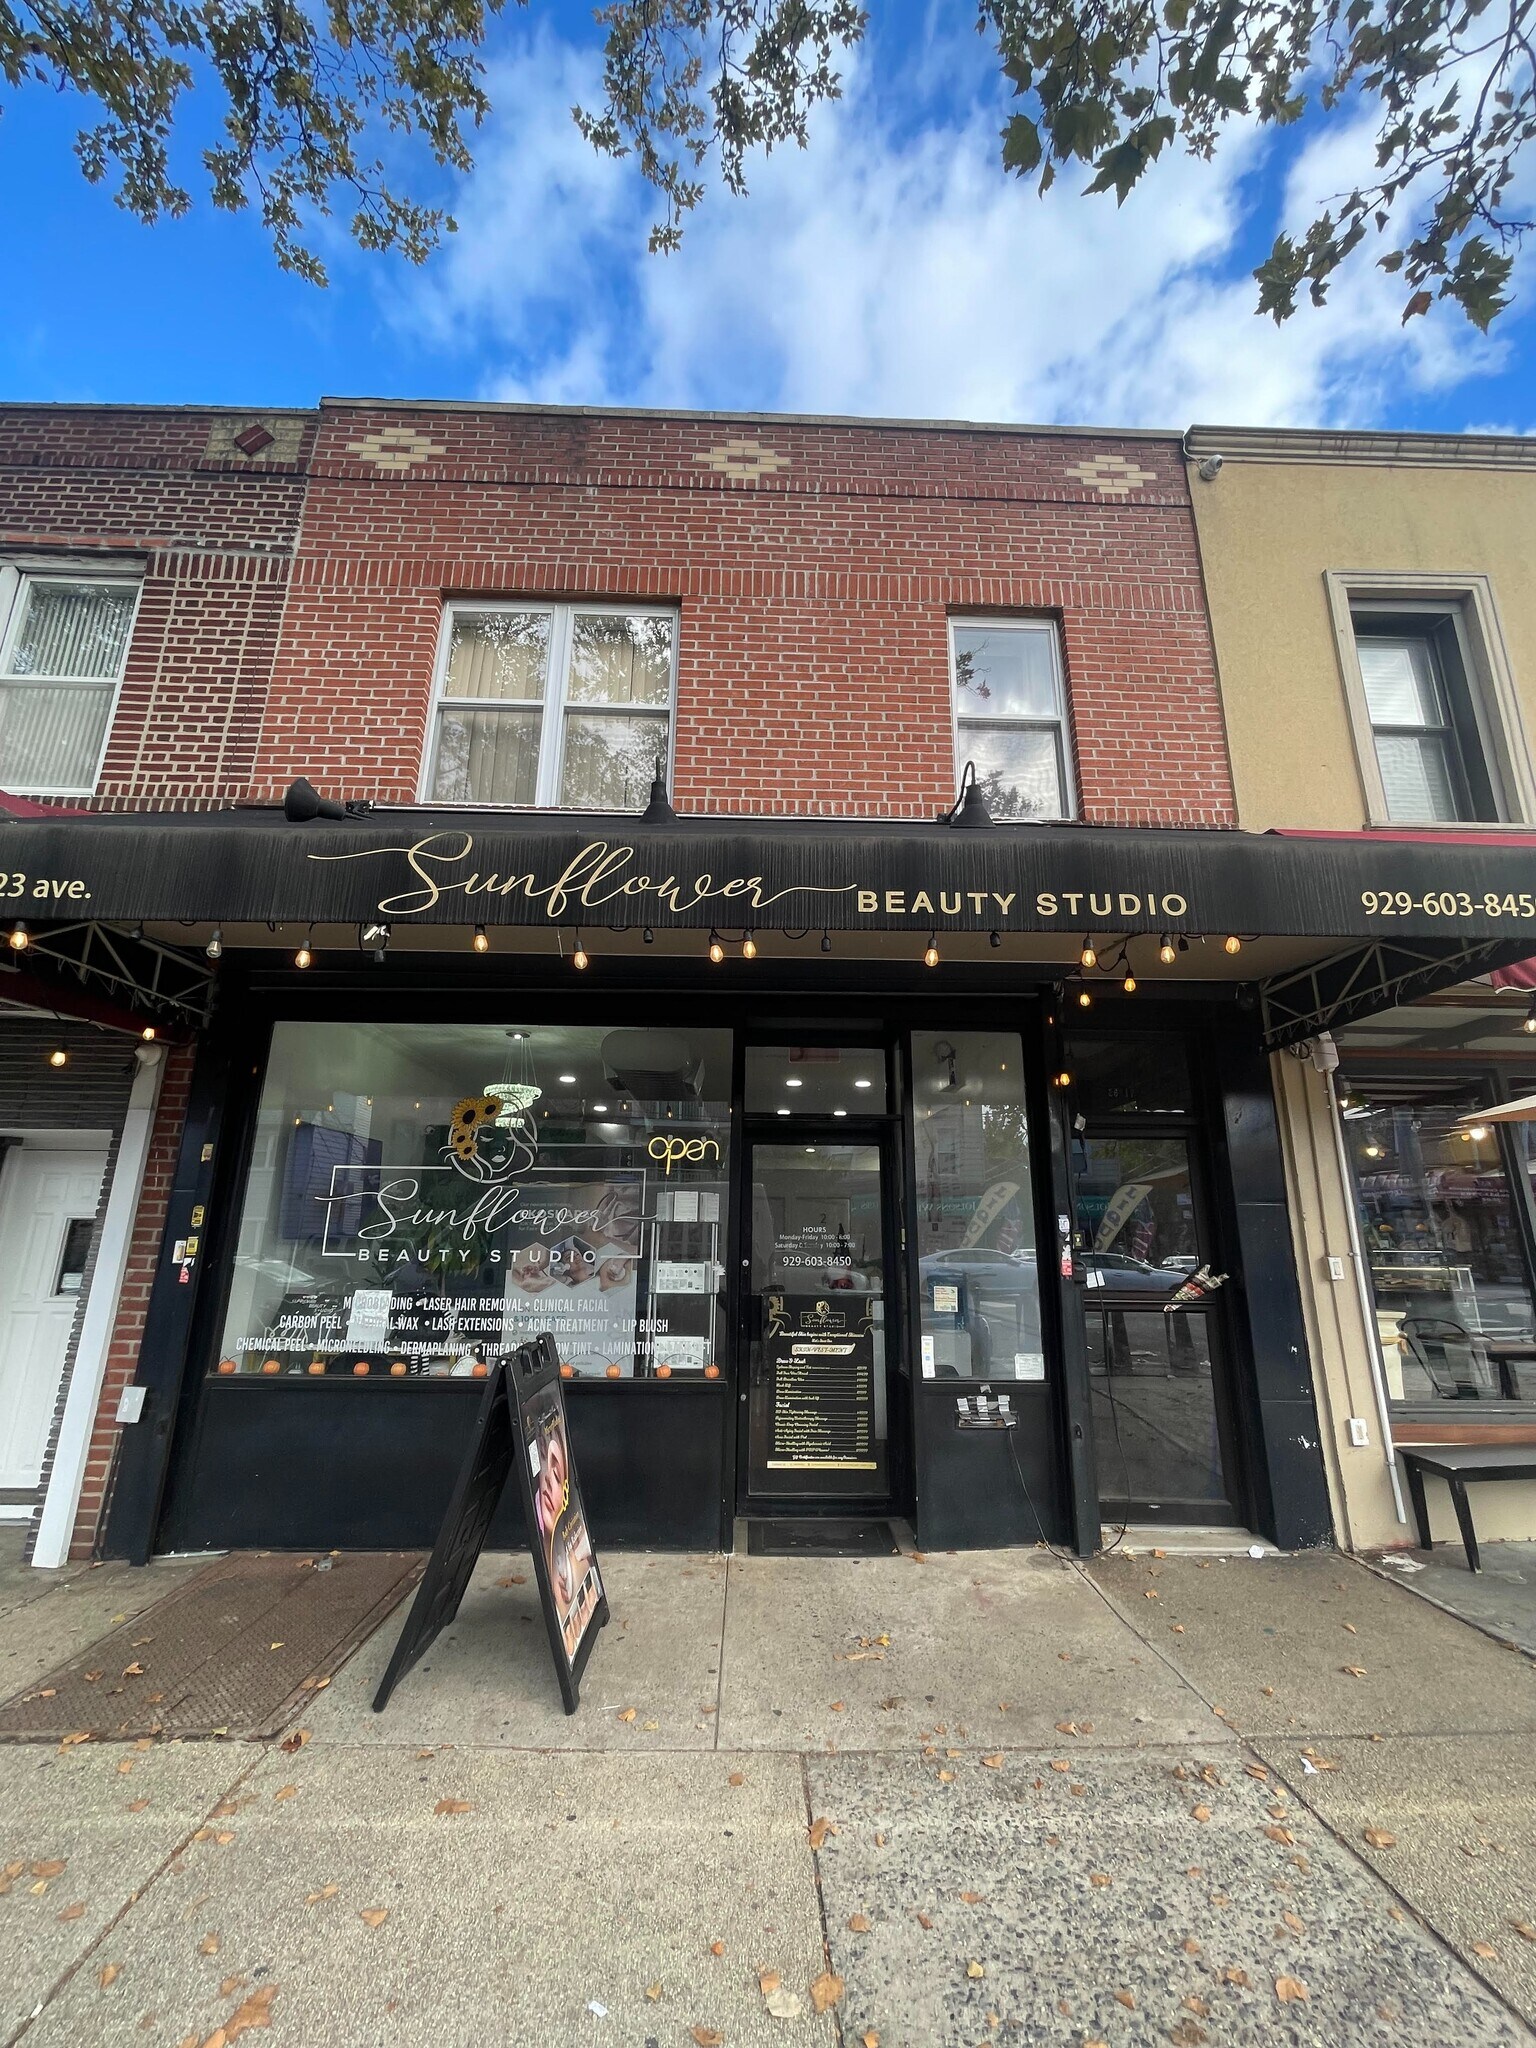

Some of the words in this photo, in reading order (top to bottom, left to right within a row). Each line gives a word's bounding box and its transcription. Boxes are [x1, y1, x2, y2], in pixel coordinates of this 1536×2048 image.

[307, 831, 857, 918] Sunflower
[856, 890, 1017, 916] BEAUTY
[1036, 893, 1188, 917] STUDIO
[32, 879, 92, 899] ave.
[1361, 891, 1536, 918] 929-603-845
[648, 1136, 720, 1175] open
[314, 1178, 658, 1241] Sunflower
[779, 1234, 819, 1242] Monday-Friday
[358, 1248, 471, 1262] BEAUTY
[489, 1249, 598, 1264] STUDIO
[782, 1256, 852, 1267] 929-603-8450
[423, 1297, 452, 1311] LASER
[454, 1297, 477, 1311] HAIR
[479, 1298, 524, 1312] REMOVAL
[533, 1298, 575, 1312] CLINICAL
[577, 1298, 608, 1312] FACIAL
[279, 1314, 317, 1329] CARBON
[320, 1315, 342, 1330] PEEL
[398, 1316, 420, 1331] WAX
[431, 1317, 455, 1331] LASH
[457, 1317, 514, 1332] EXTENSIONS
[527, 1318, 553, 1332] ACNE
[555, 1318, 608, 1333] TREATMENT
[622, 1319, 637, 1333] LIP
[639, 1319, 669, 1333] BLUSH
[236, 1337, 281, 1352] CHEMICAL
[284, 1338, 306, 1352] PEEL
[317, 1338, 390, 1354] MICRONEEDLING
[400, 1340, 471, 1356] DERMAPLANING
[570, 1342, 594, 1355] TINT
